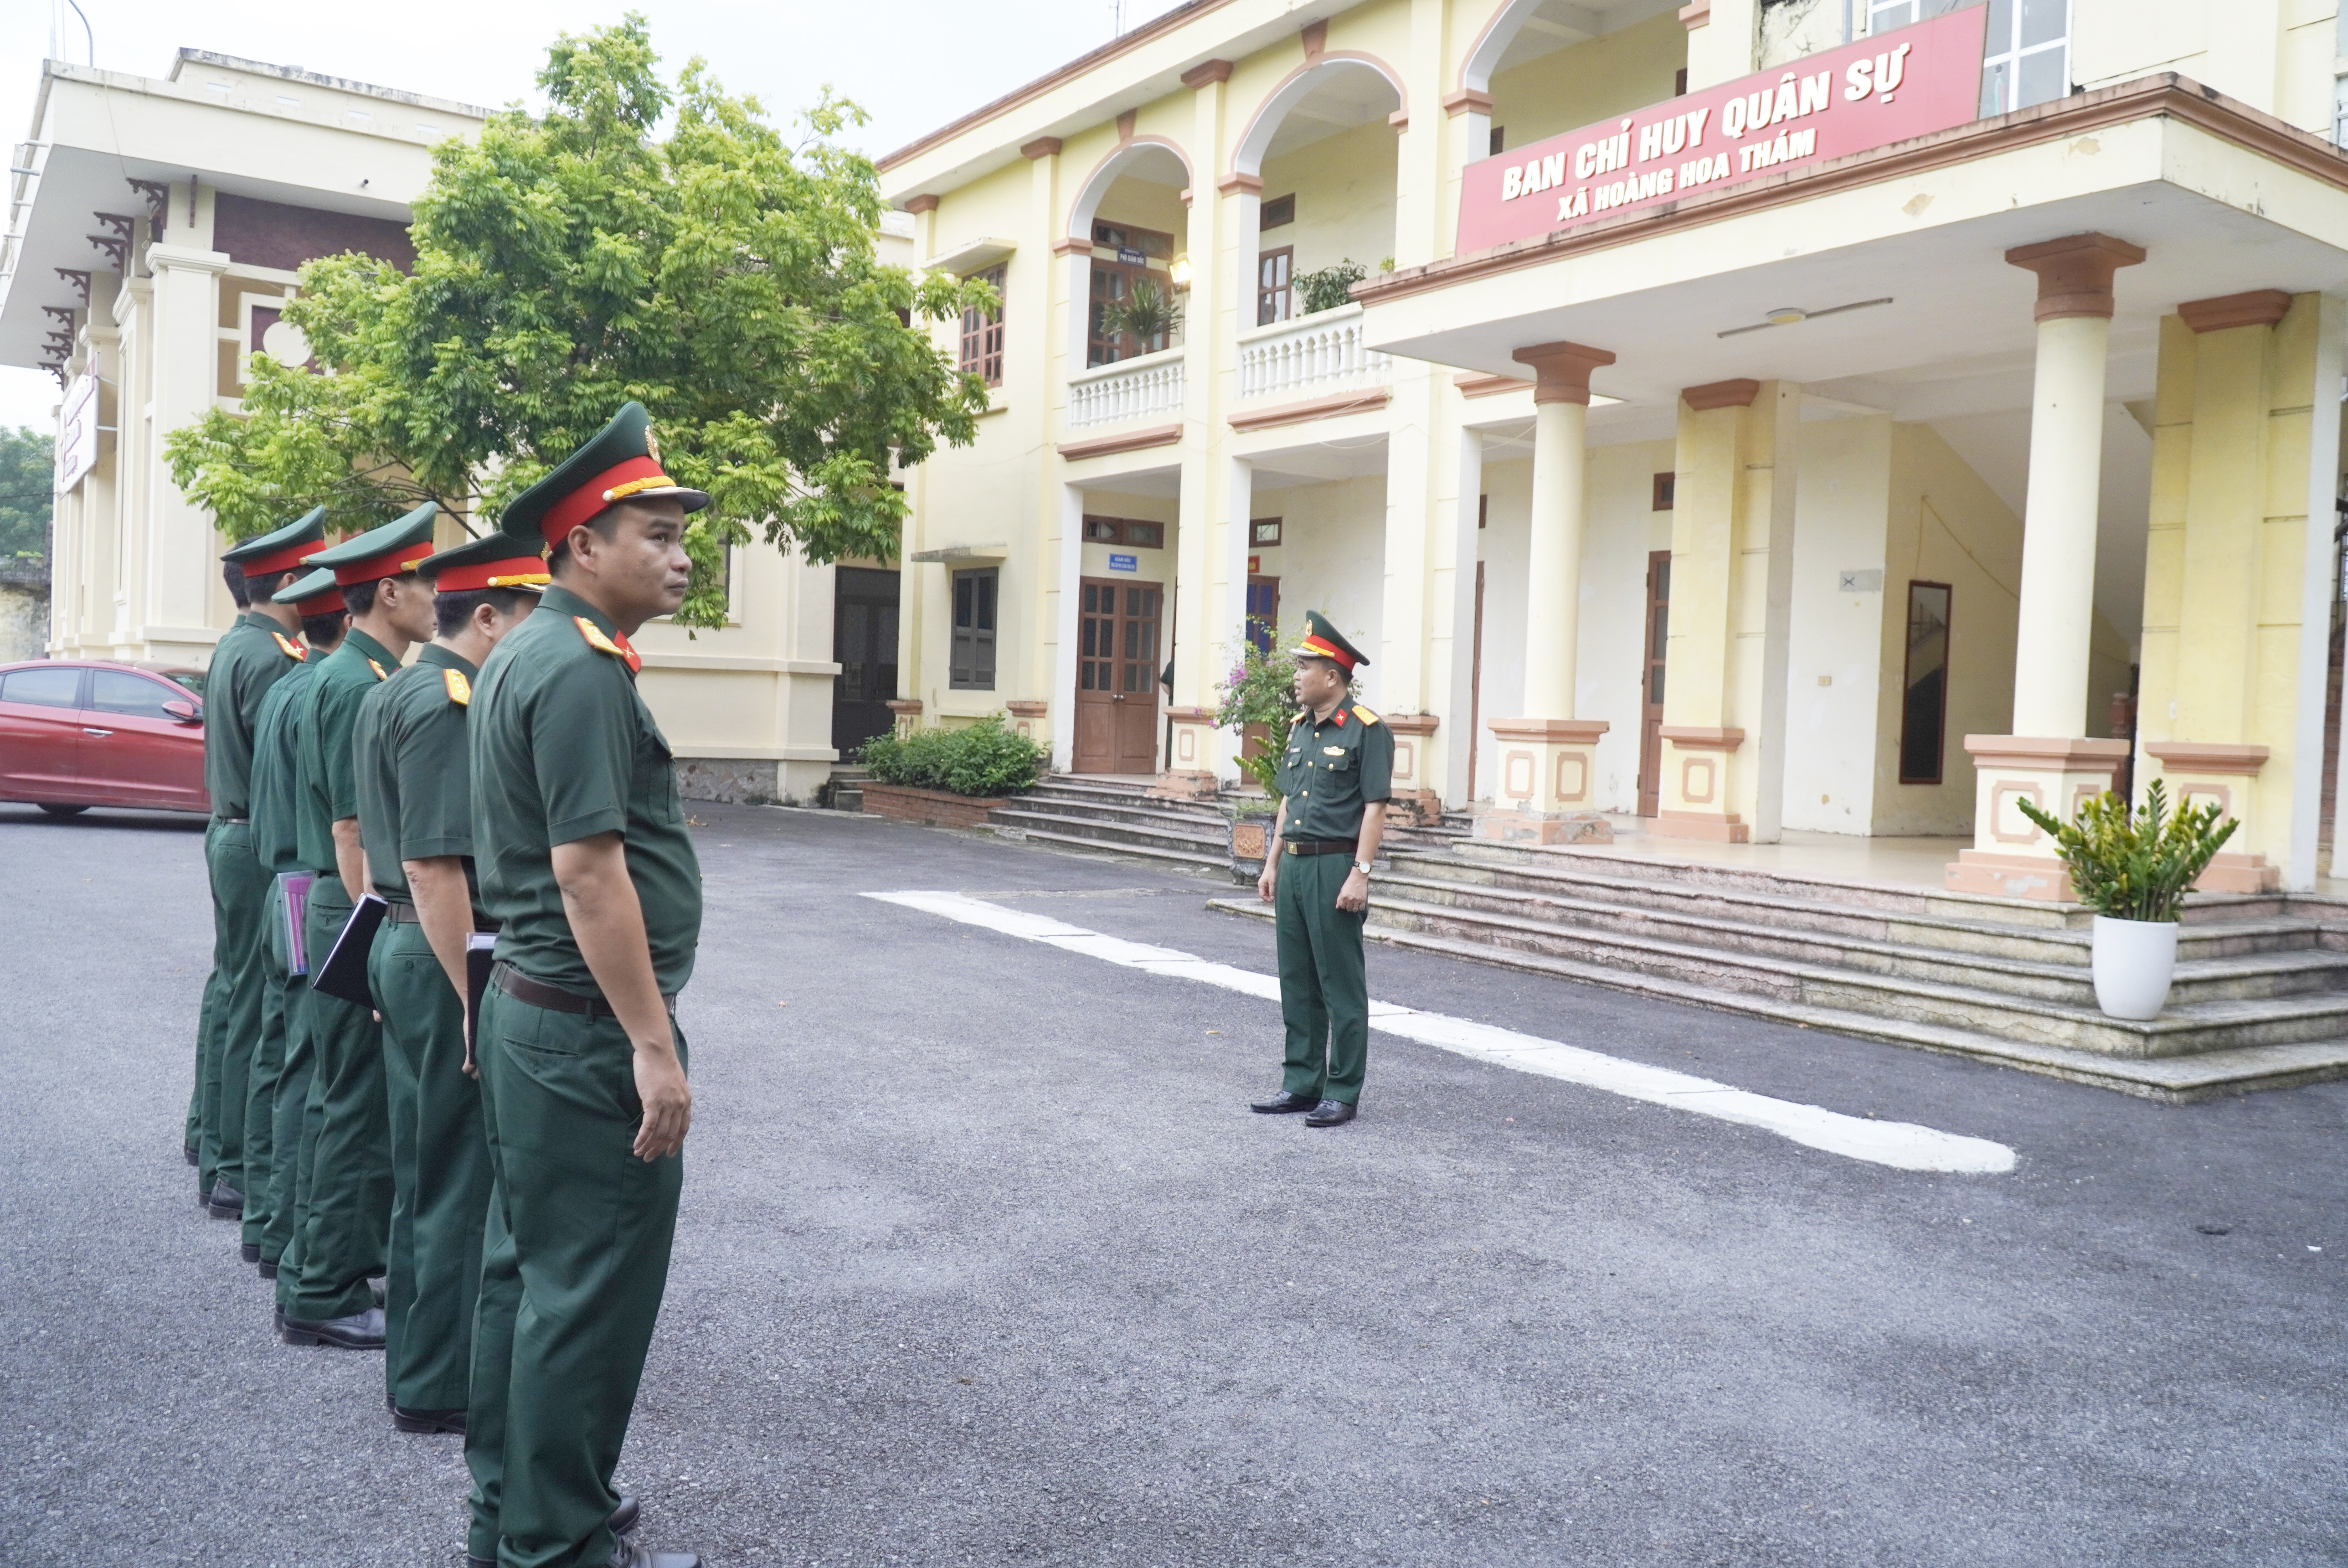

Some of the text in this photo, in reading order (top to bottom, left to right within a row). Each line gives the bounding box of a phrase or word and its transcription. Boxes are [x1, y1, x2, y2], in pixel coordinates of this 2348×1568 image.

[1501, 42, 1912, 202] BAN CHỈ HUY QUÂN SỰ
[1557, 128, 1817, 221] XÃ HOÀNG HOA THÁM
